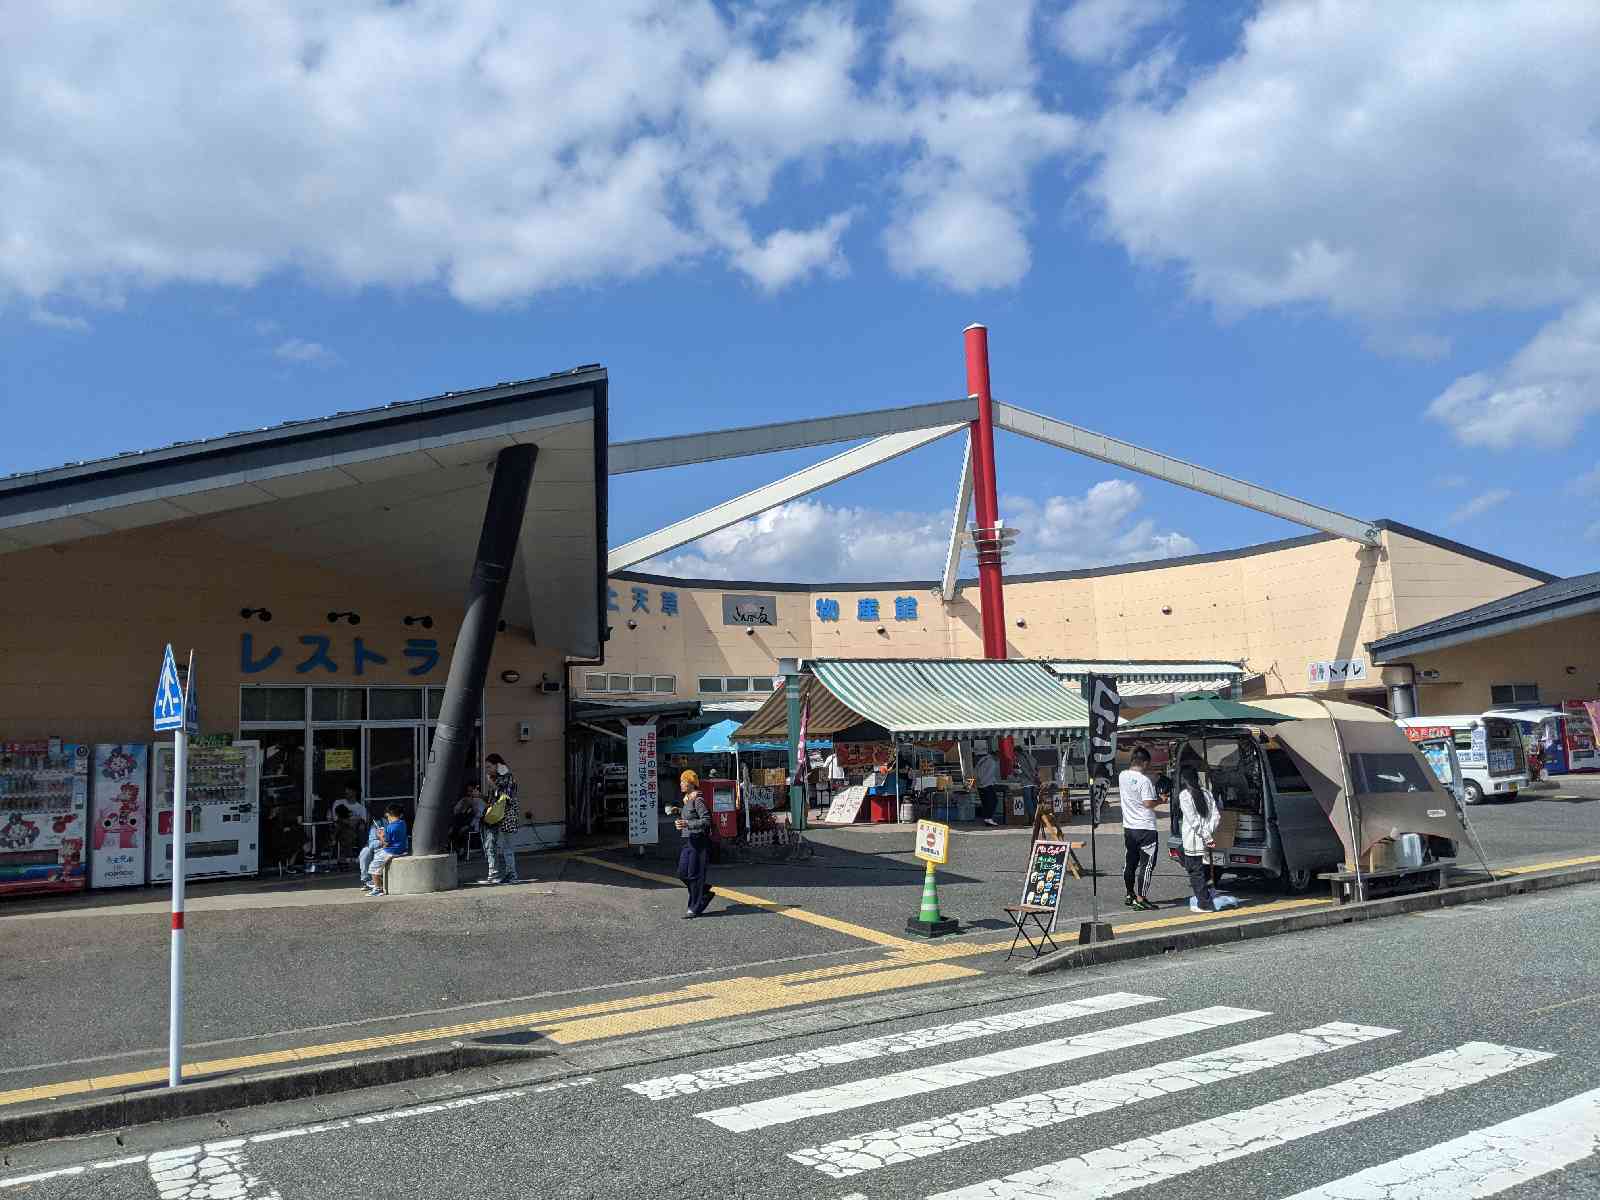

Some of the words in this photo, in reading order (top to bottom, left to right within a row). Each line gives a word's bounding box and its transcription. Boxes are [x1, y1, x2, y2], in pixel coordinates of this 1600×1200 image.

[815, 596, 918, 623] 物産館
[1329, 663, 1362, 678] トイレ
